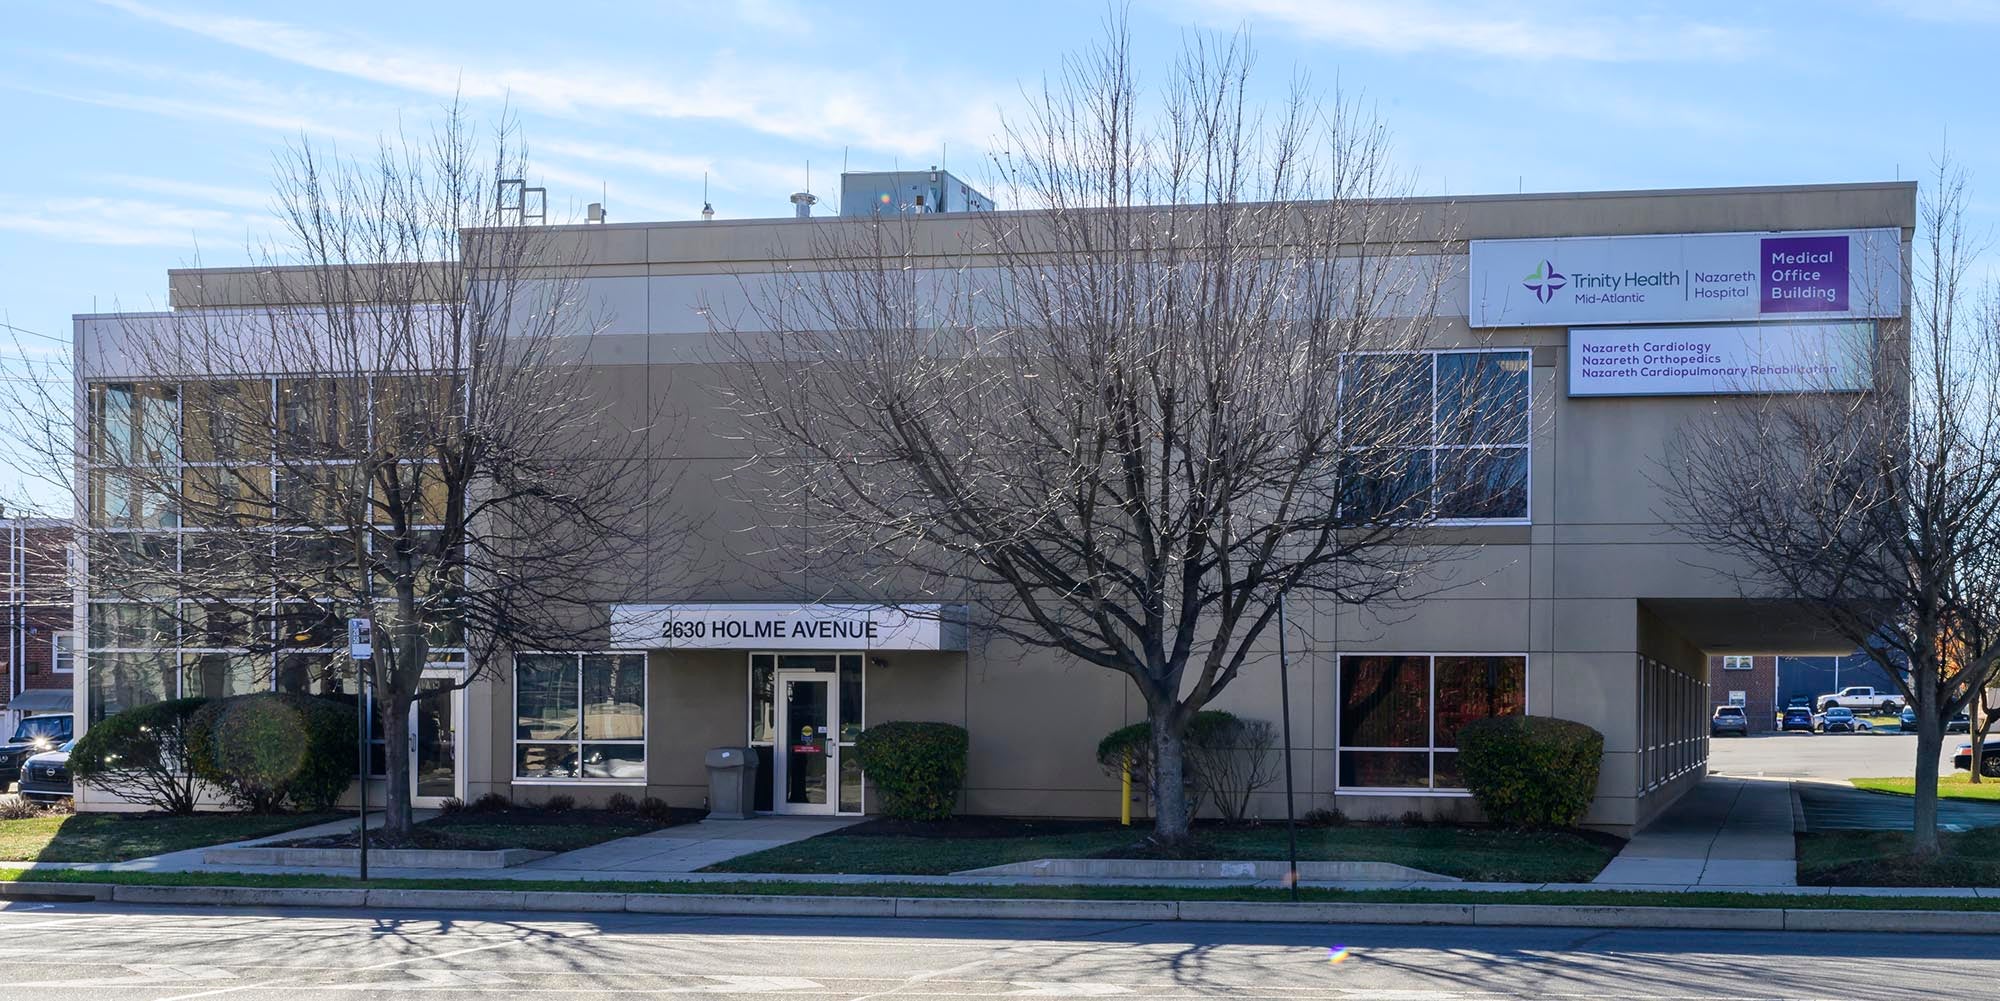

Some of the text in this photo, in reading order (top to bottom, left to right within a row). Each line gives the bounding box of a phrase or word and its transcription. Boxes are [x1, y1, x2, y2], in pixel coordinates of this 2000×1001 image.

[1771, 251, 1833, 265] Medical
[1571, 272, 1680, 291] Trinity Health
[1694, 271, 1756, 283] Nazareth
[1771, 269, 1821, 282] Office
[1575, 292, 1645, 304] Mid-Atlantic
[1694, 286, 1749, 300] Hospital
[1771, 286, 1836, 302] Building
[1582, 342, 1712, 355] Nazareth Cardiology
[1582, 354, 1721, 366] Nazareth Orthopedics
[1582, 365, 1838, 378] Nazareth Cardiopulmonary Rehabilitation
[662, 621, 878, 639] 2630 HOLME AVENUE
